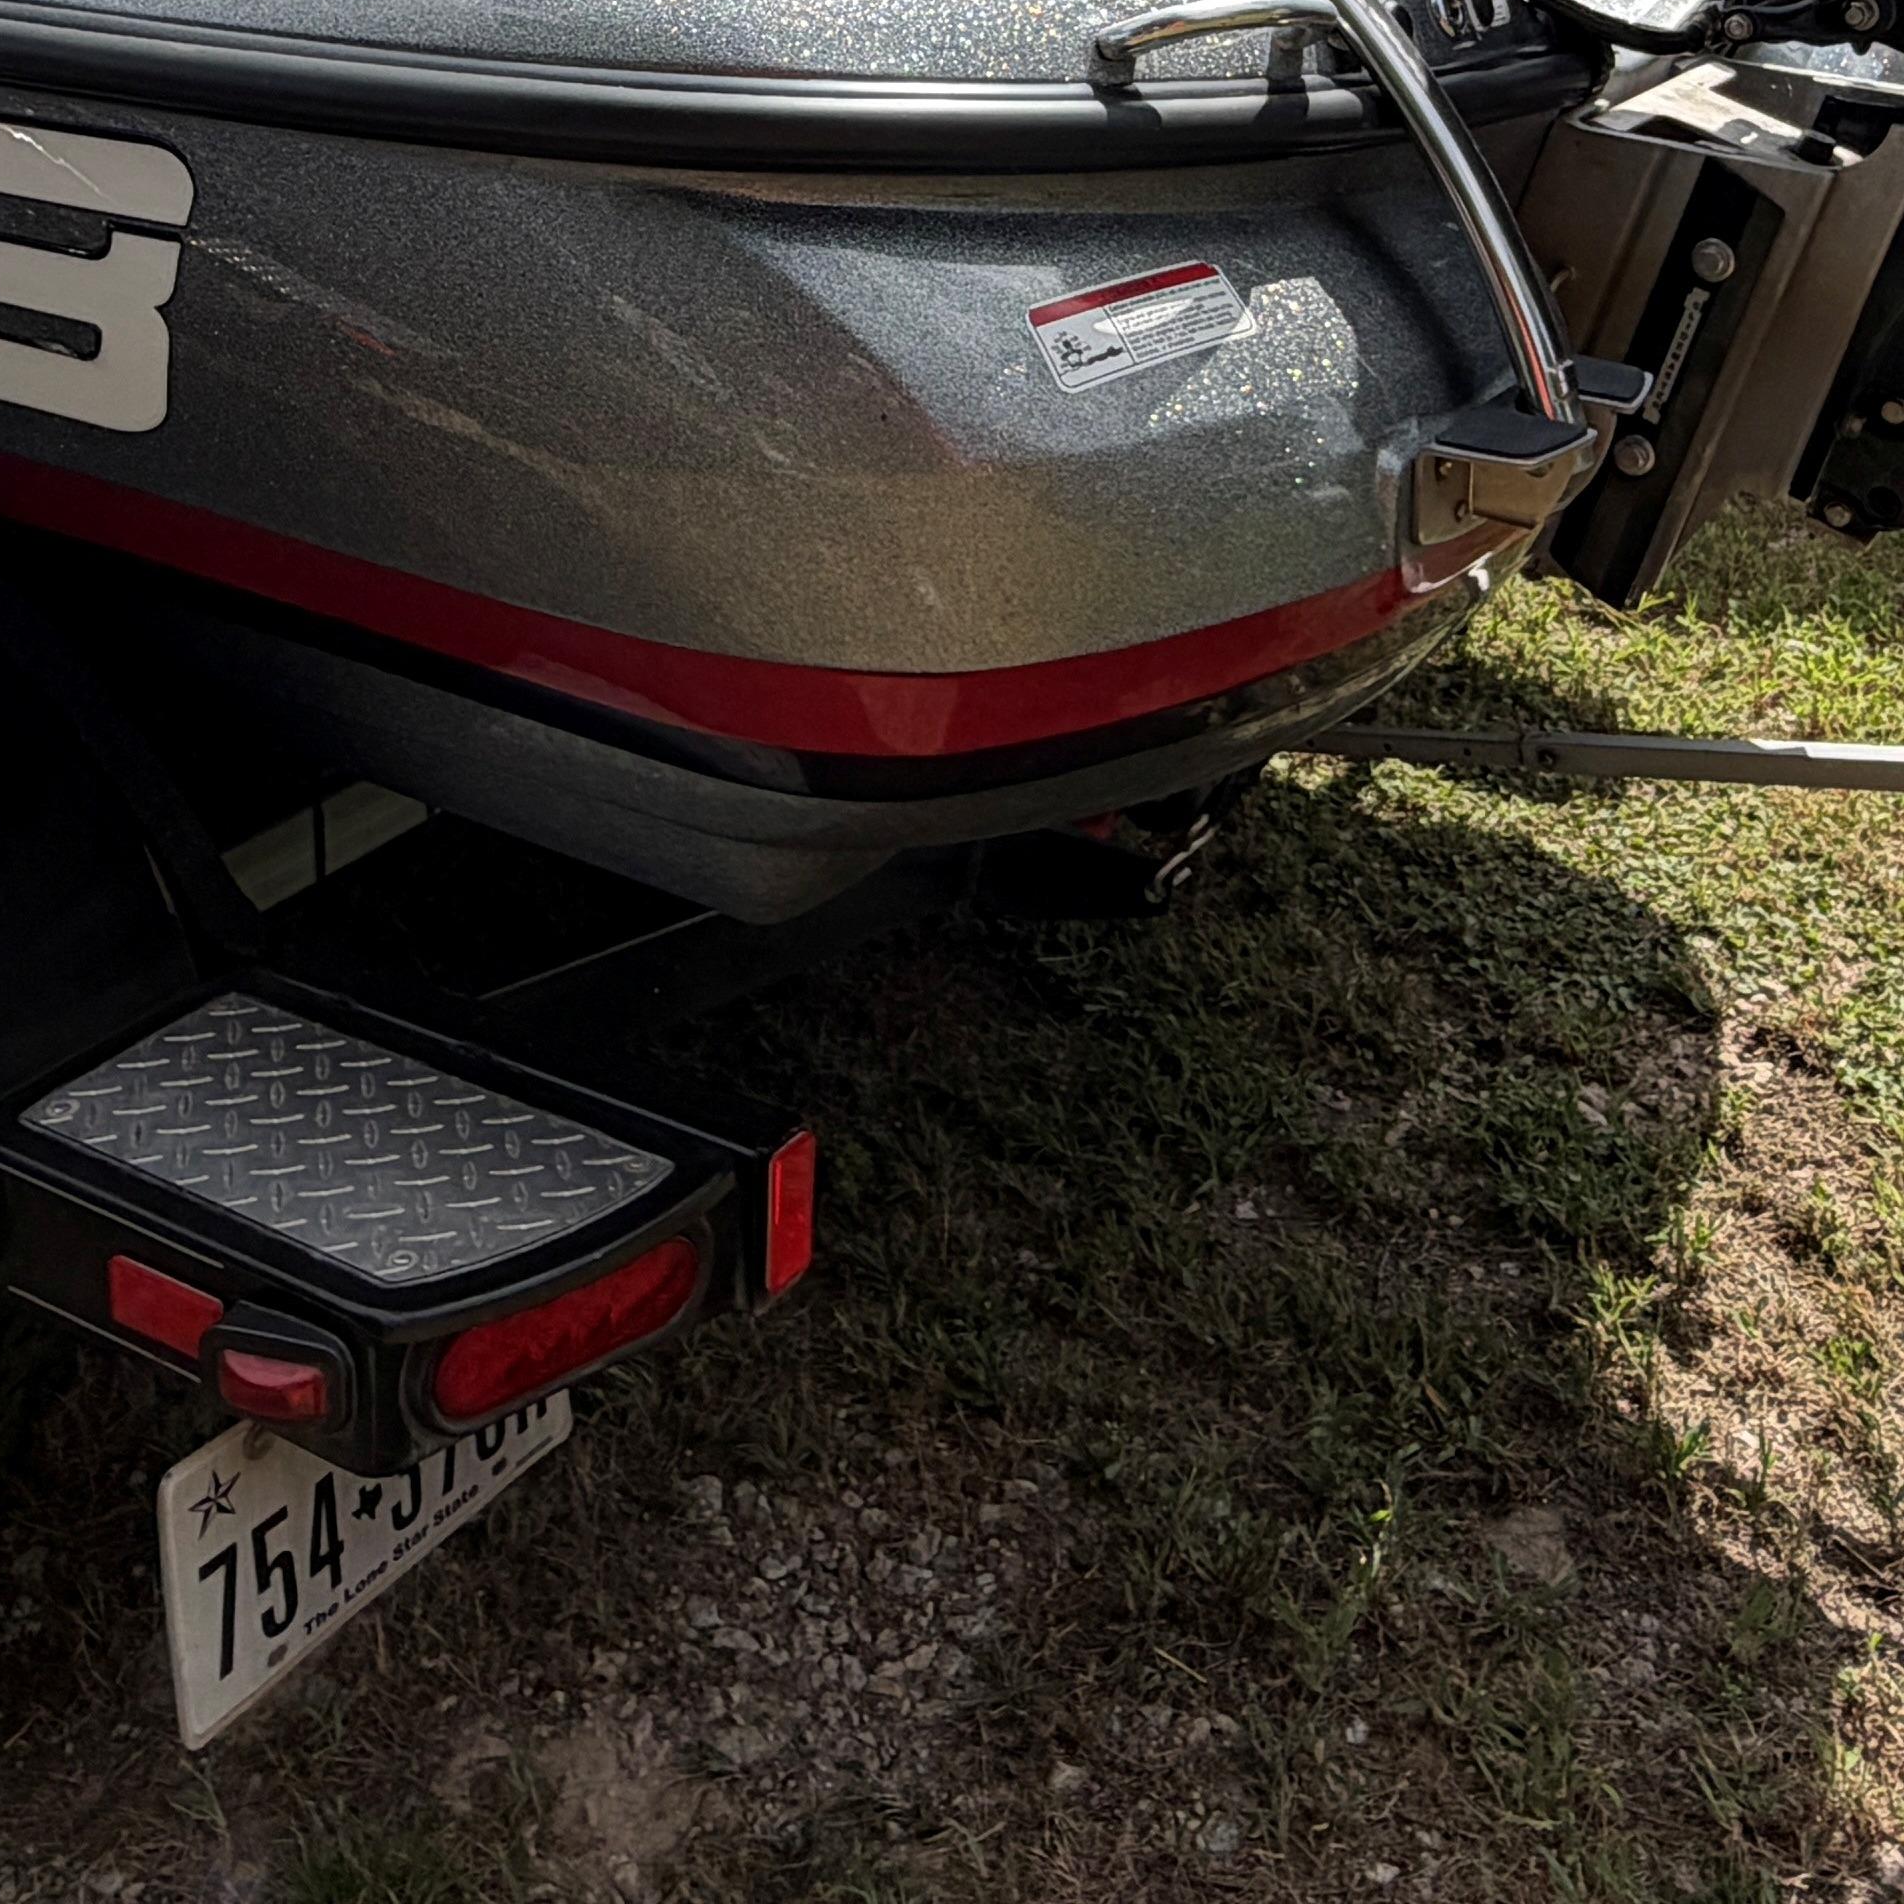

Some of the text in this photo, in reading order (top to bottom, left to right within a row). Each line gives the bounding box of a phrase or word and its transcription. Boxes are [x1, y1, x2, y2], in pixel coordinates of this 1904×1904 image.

[303, 1483, 480, 1637] The Lone Star State
